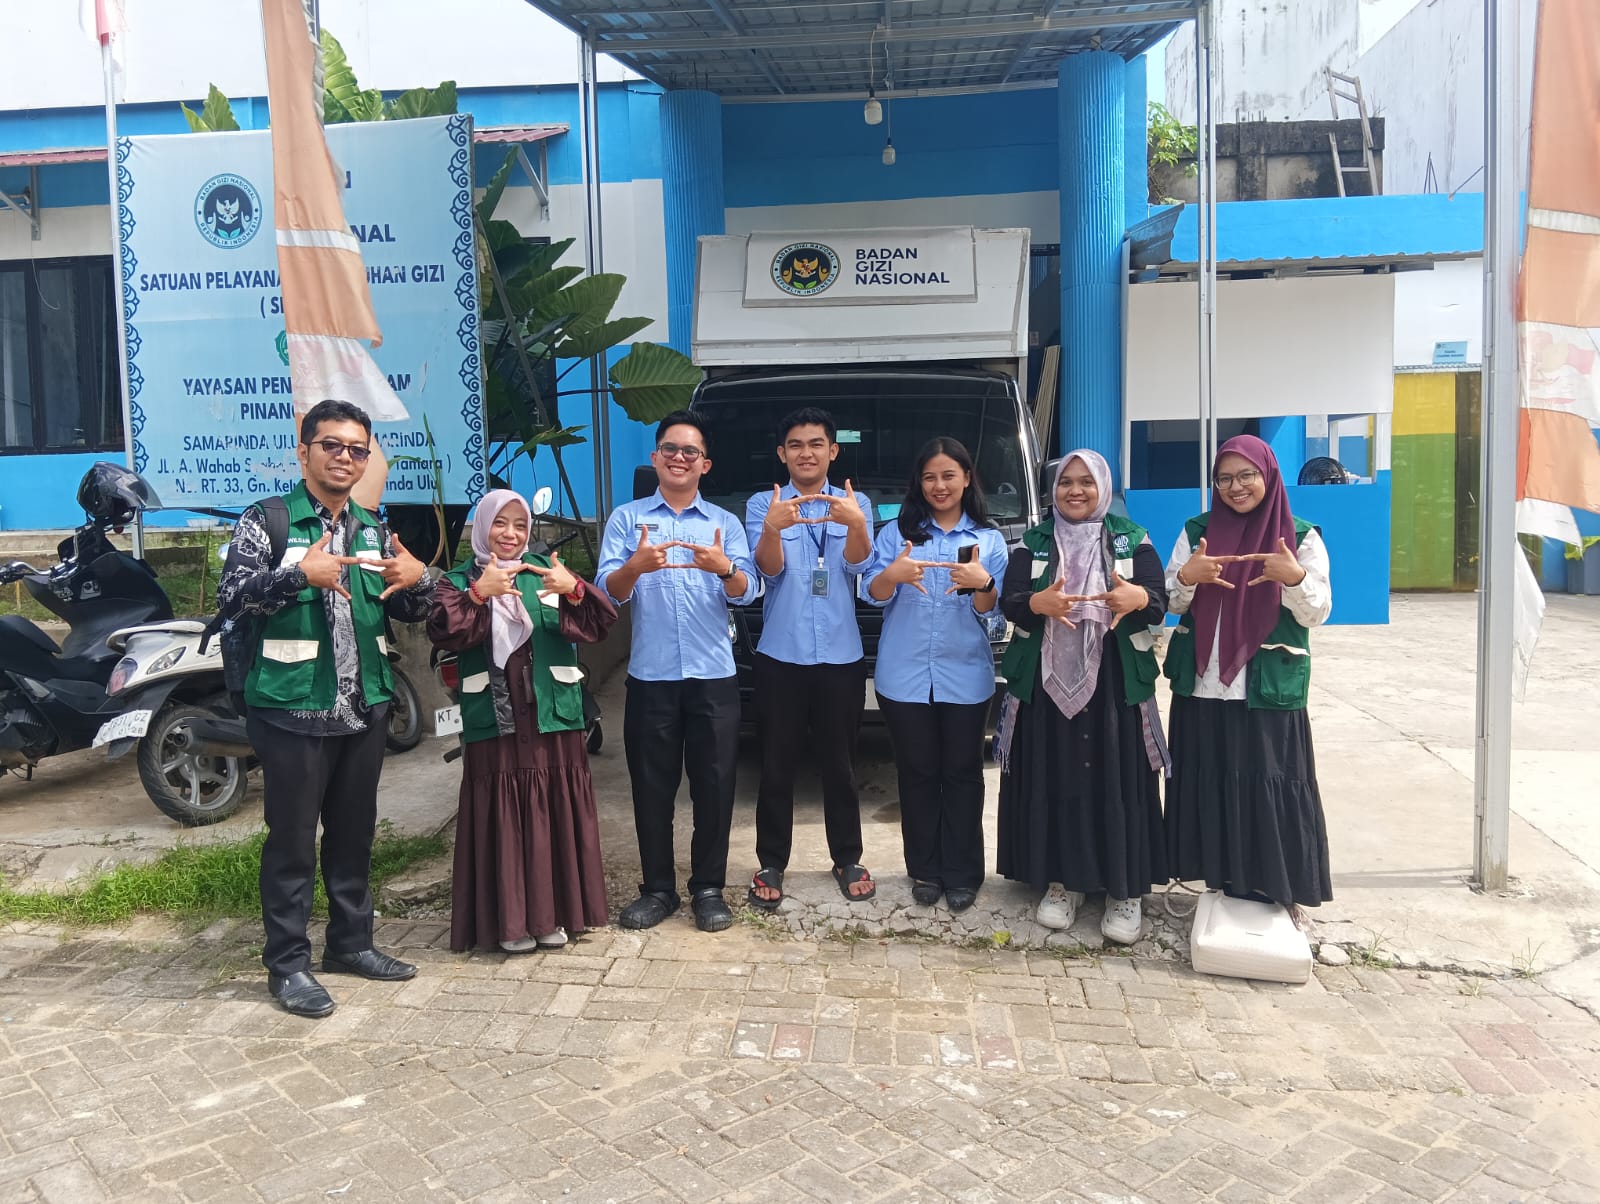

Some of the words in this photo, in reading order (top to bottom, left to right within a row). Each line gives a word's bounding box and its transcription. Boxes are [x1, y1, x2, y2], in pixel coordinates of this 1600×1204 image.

[350, 224, 396, 243] NAL
[855, 247, 918, 260] BADAN
[855, 260, 892, 272] GIZI
[140, 272, 201, 291] SATUAN
[366, 265, 407, 284] HAN
[411, 264, 445, 283] GIZI
[855, 272, 950, 285] NASIONAL
[183, 377, 257, 395] YAYASAN
[262, 376, 293, 394] PEN
[387, 374, 411, 391] AM
[241, 402, 295, 420] PINAN
[196, 457, 241, 474] Wahab
[202, 478, 220, 494] RT.
[224, 478, 244, 495] 33,
[248, 477, 271, 493] Gn.
[386, 475, 414, 491] inda
[438, 709, 452, 723] KT
